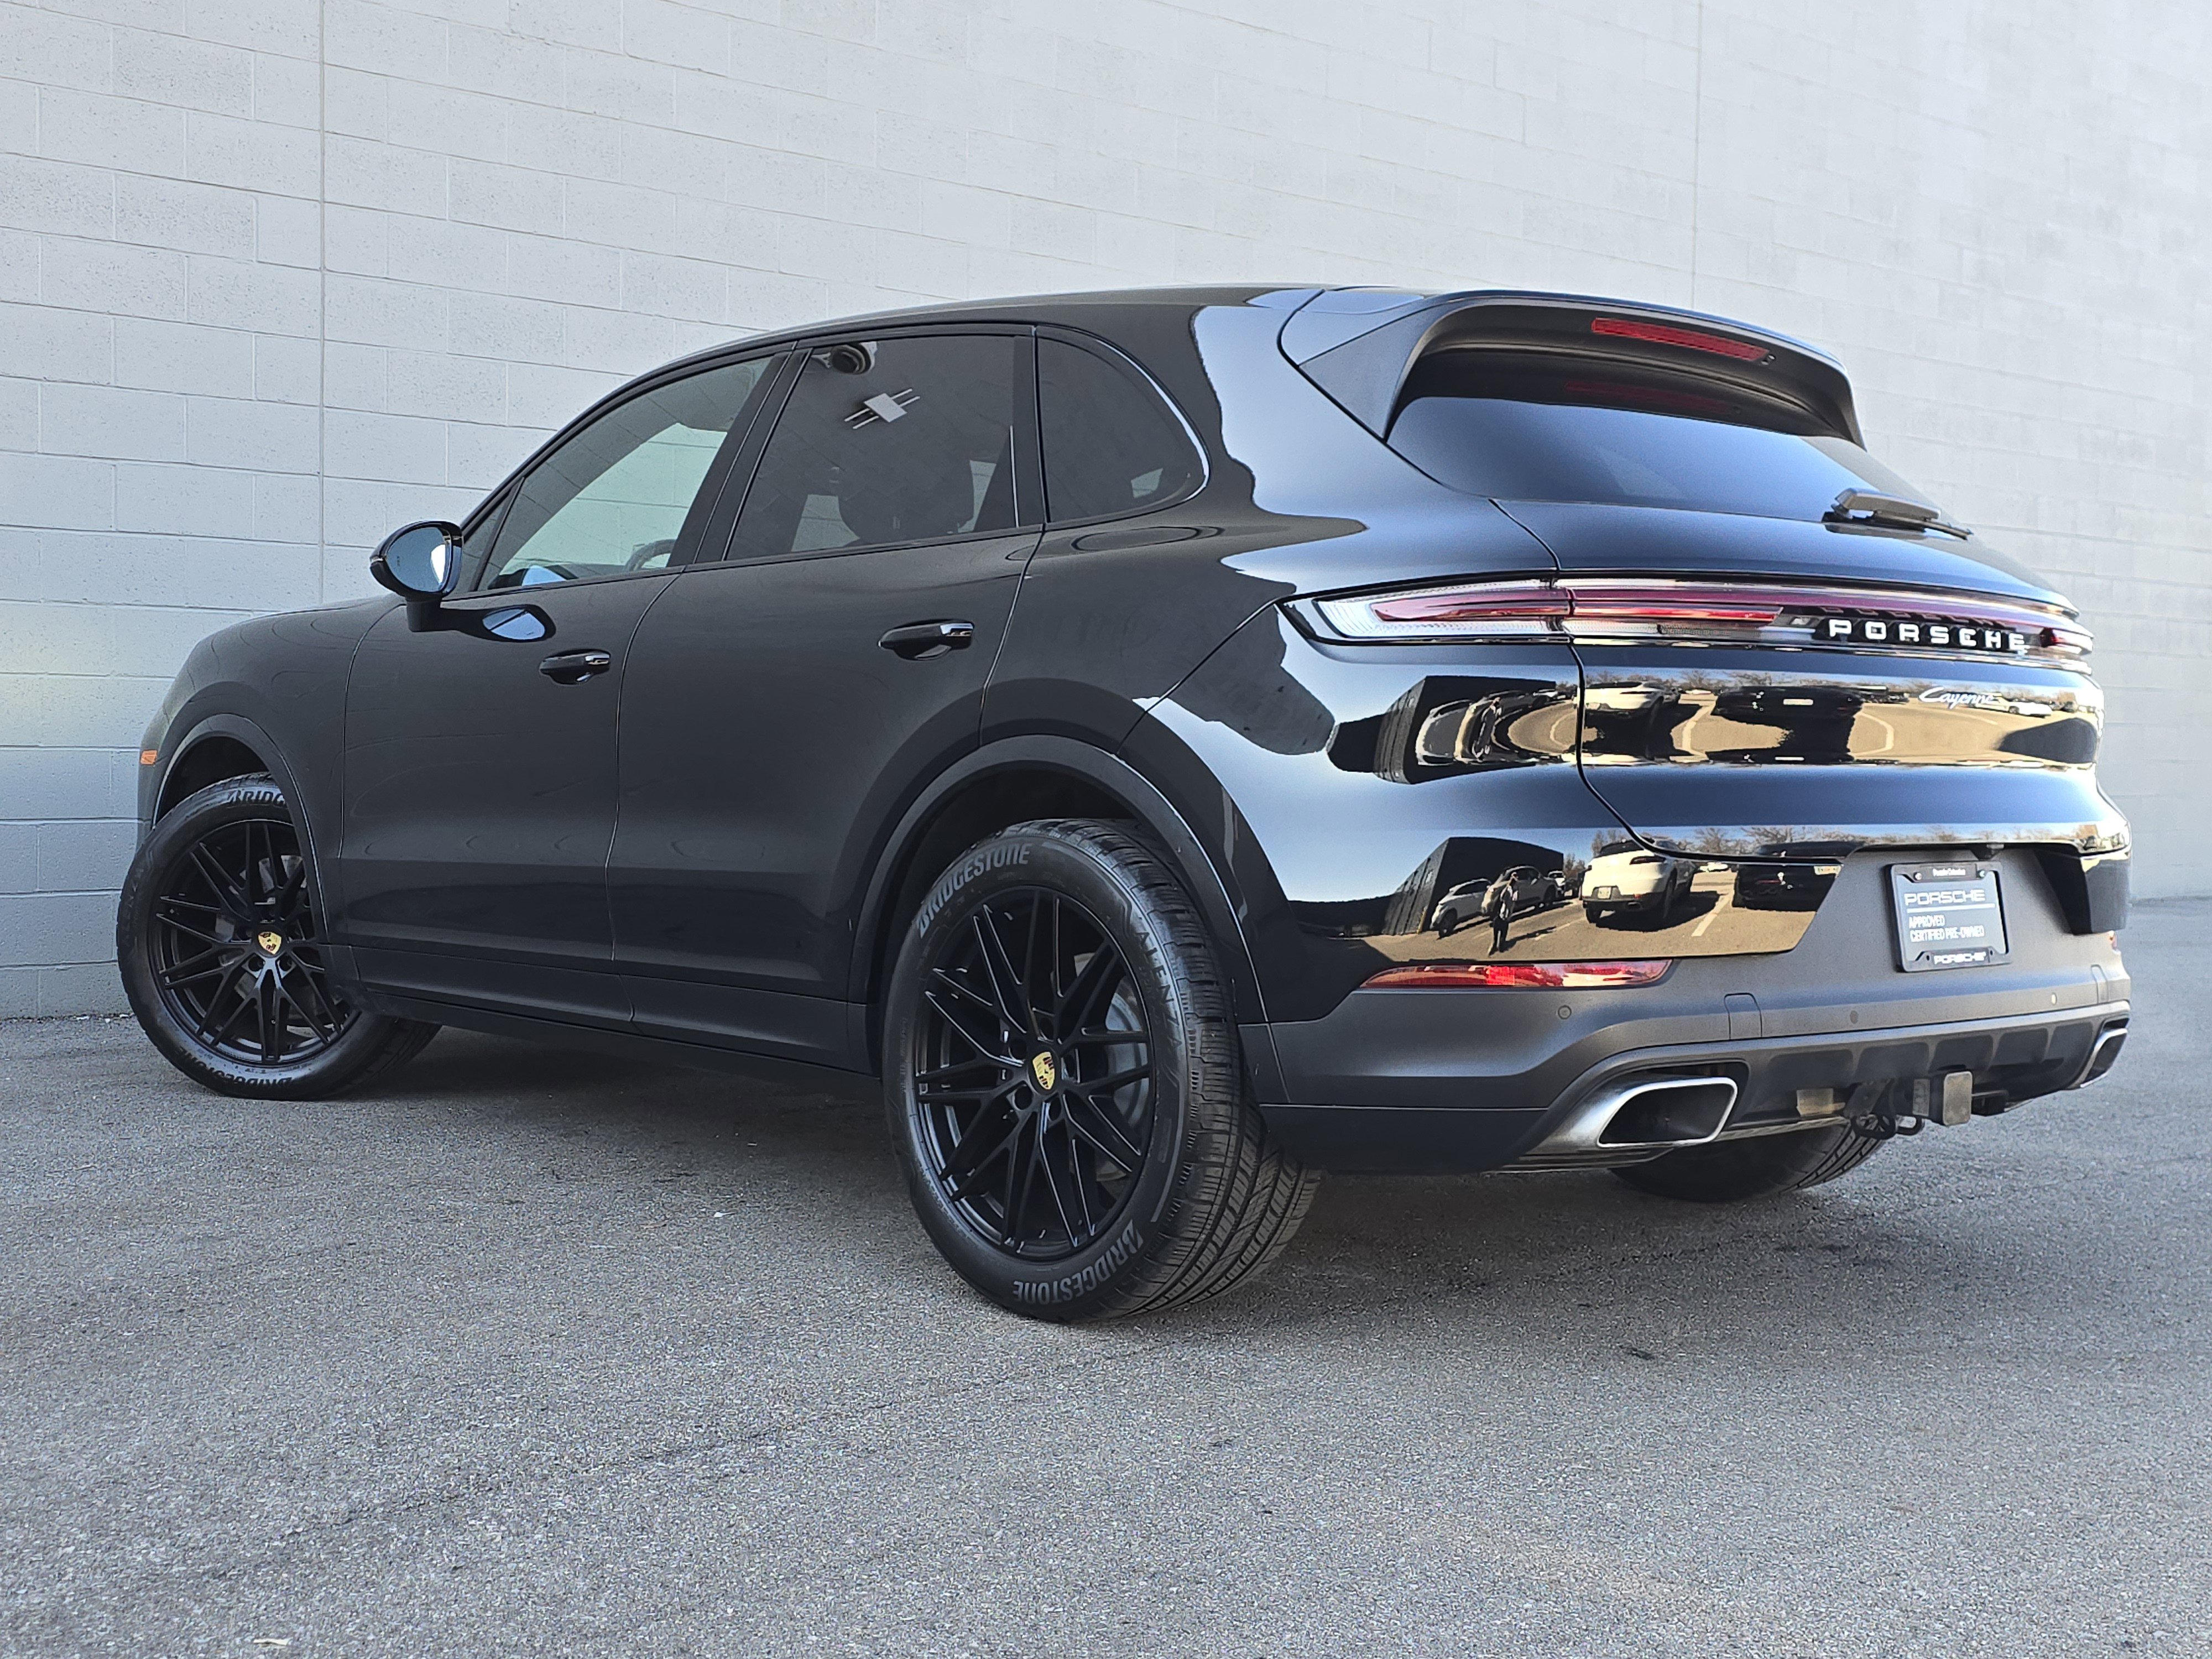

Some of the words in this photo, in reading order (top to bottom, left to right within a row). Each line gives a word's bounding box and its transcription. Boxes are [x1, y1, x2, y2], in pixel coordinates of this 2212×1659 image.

[1828, 619, 2026, 649] PORSCHE
[1918, 687, 1995, 709] Cayenne
[227, 790, 287, 808] BRIDG
[916, 842, 1033, 940] BRIDGESTONE
[1904, 889, 1985, 906] PORSCHE
[1909, 915, 1945, 928] APPROVED
[1910, 928, 1945, 942] CERTIFIED
[1945, 925, 1985, 939] PRE-OWNED
[1135, 932, 1182, 1051] ALENZA
[1012, 1218, 1144, 1305] BRIDGESTONE
